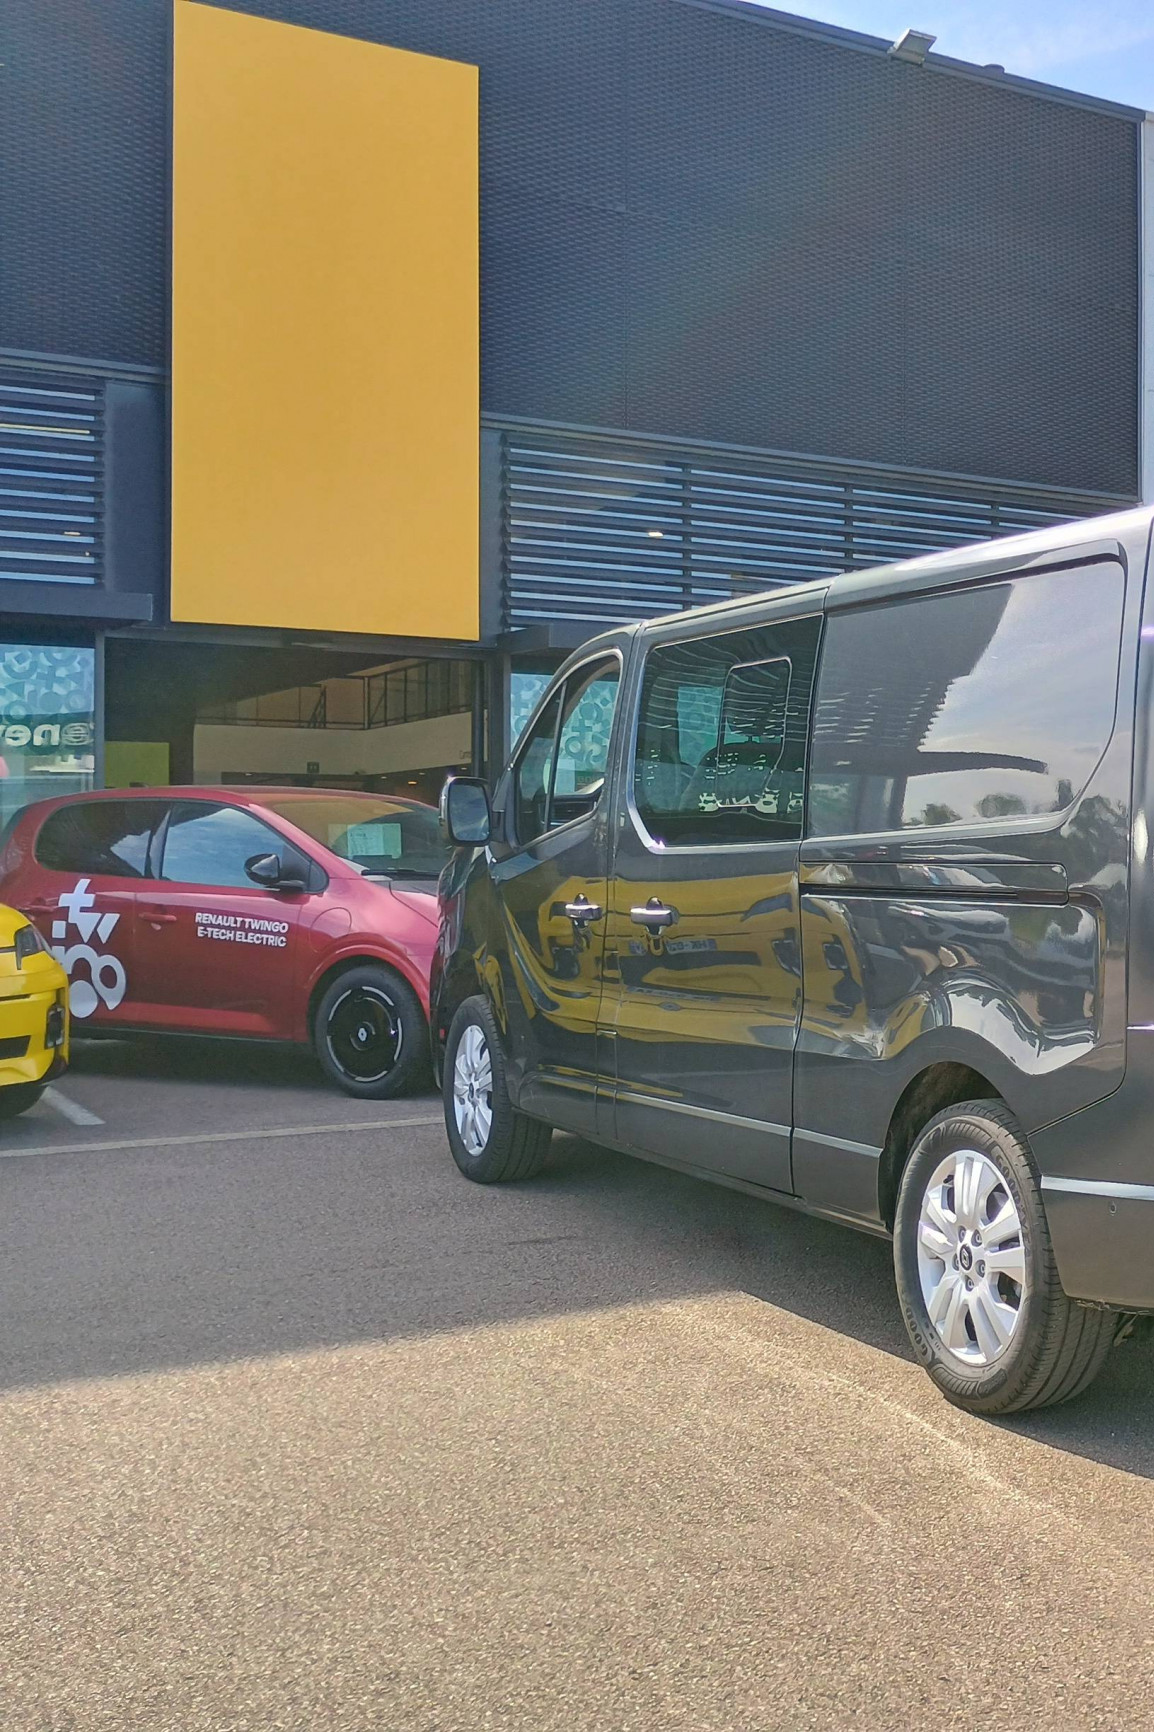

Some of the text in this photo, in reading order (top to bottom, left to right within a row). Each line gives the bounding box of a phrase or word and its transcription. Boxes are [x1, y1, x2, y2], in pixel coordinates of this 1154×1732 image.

[195, 912, 289, 934] RENAULT TWINGO
[197, 926, 287, 947] E-TECH ELECTRIC
